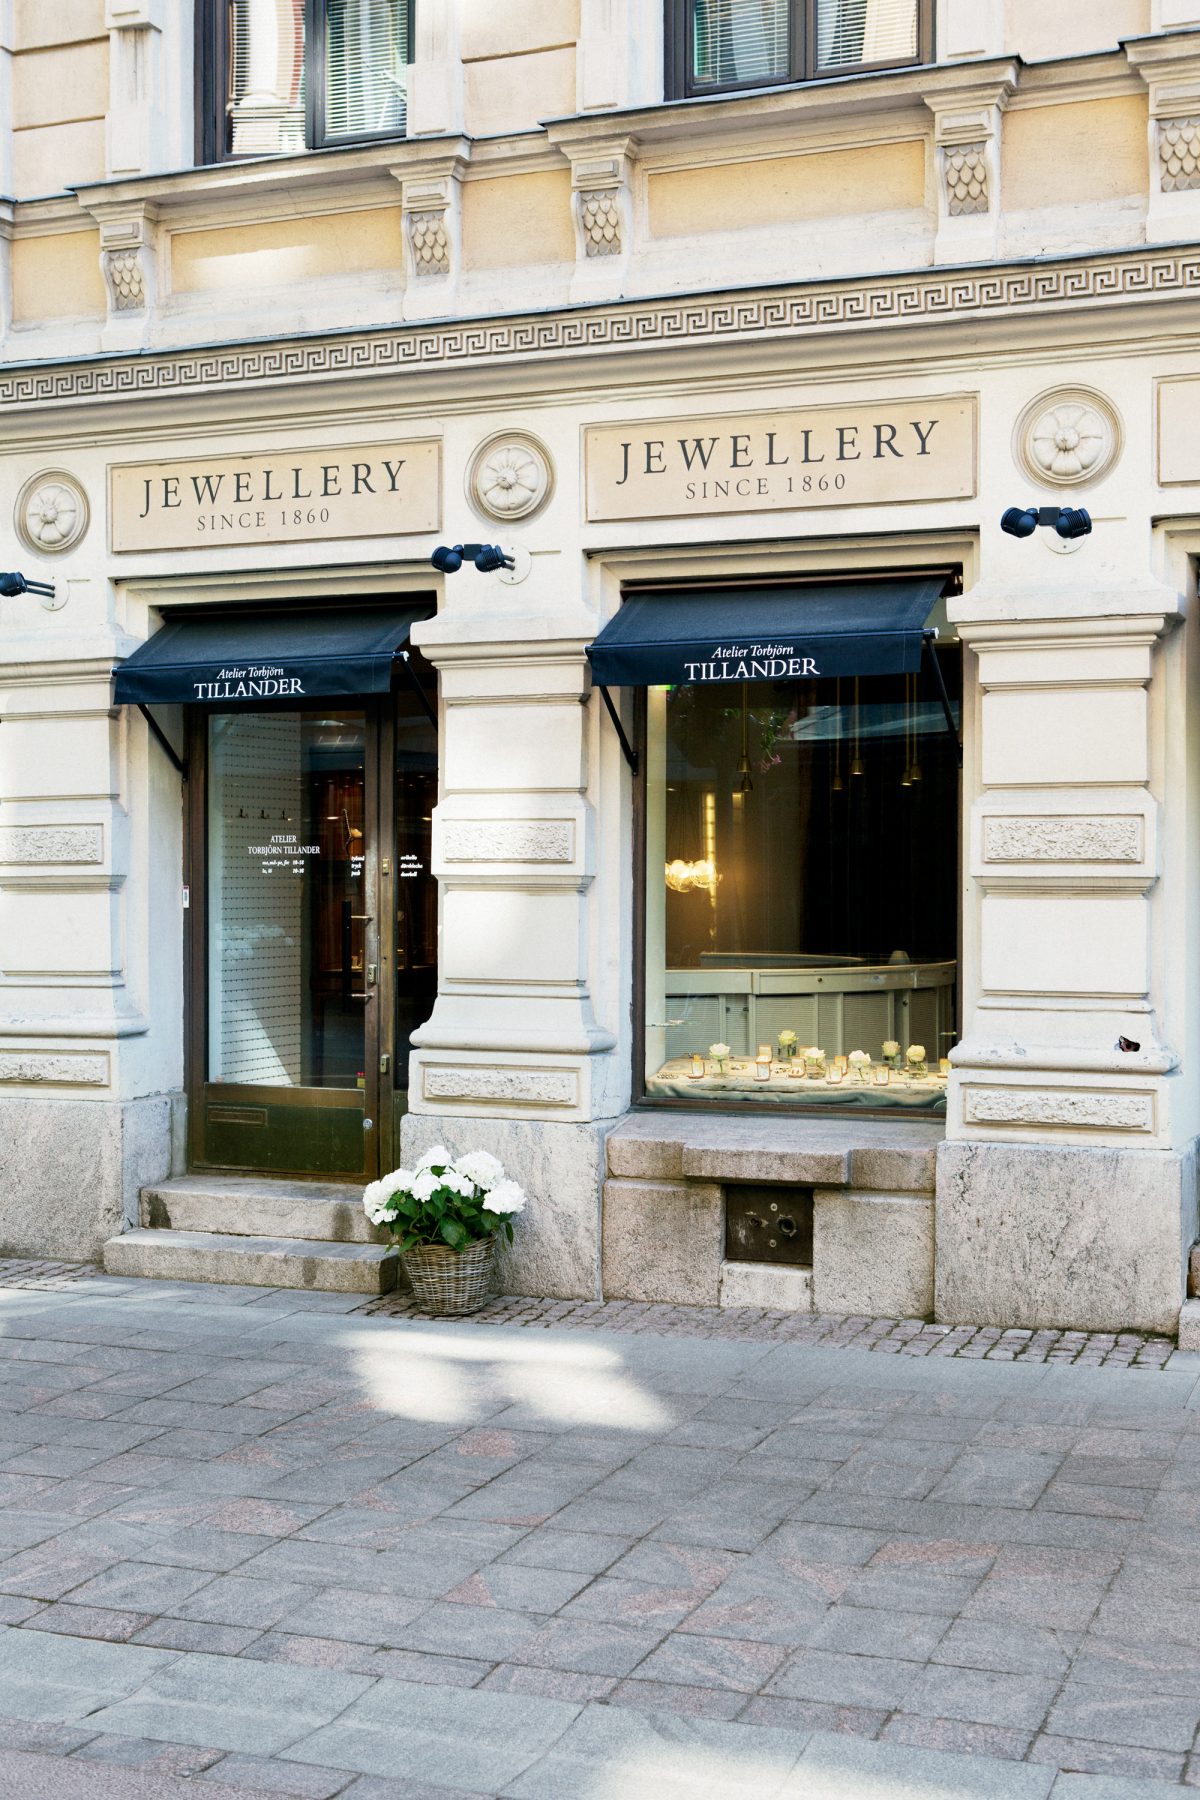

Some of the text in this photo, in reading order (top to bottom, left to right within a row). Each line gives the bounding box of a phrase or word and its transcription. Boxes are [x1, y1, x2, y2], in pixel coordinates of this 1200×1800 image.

[616, 420, 939, 485] JEWELLERY
[139, 460, 407, 518] JEWELLERY
[685, 473, 846, 500] SINCE 1860
[197, 507, 330, 531] SINCE 1860
[711, 644, 794, 660] Atelier Torbjörn
[216, 666, 284, 680] Atelier Torbjörn
[684, 657, 821, 681] TILLANDER
[193, 677, 305, 699] TILLANDER
[247, 844, 321, 856] TORBJÖRN TILLANDER
[270, 835, 297, 843] ATELIER
